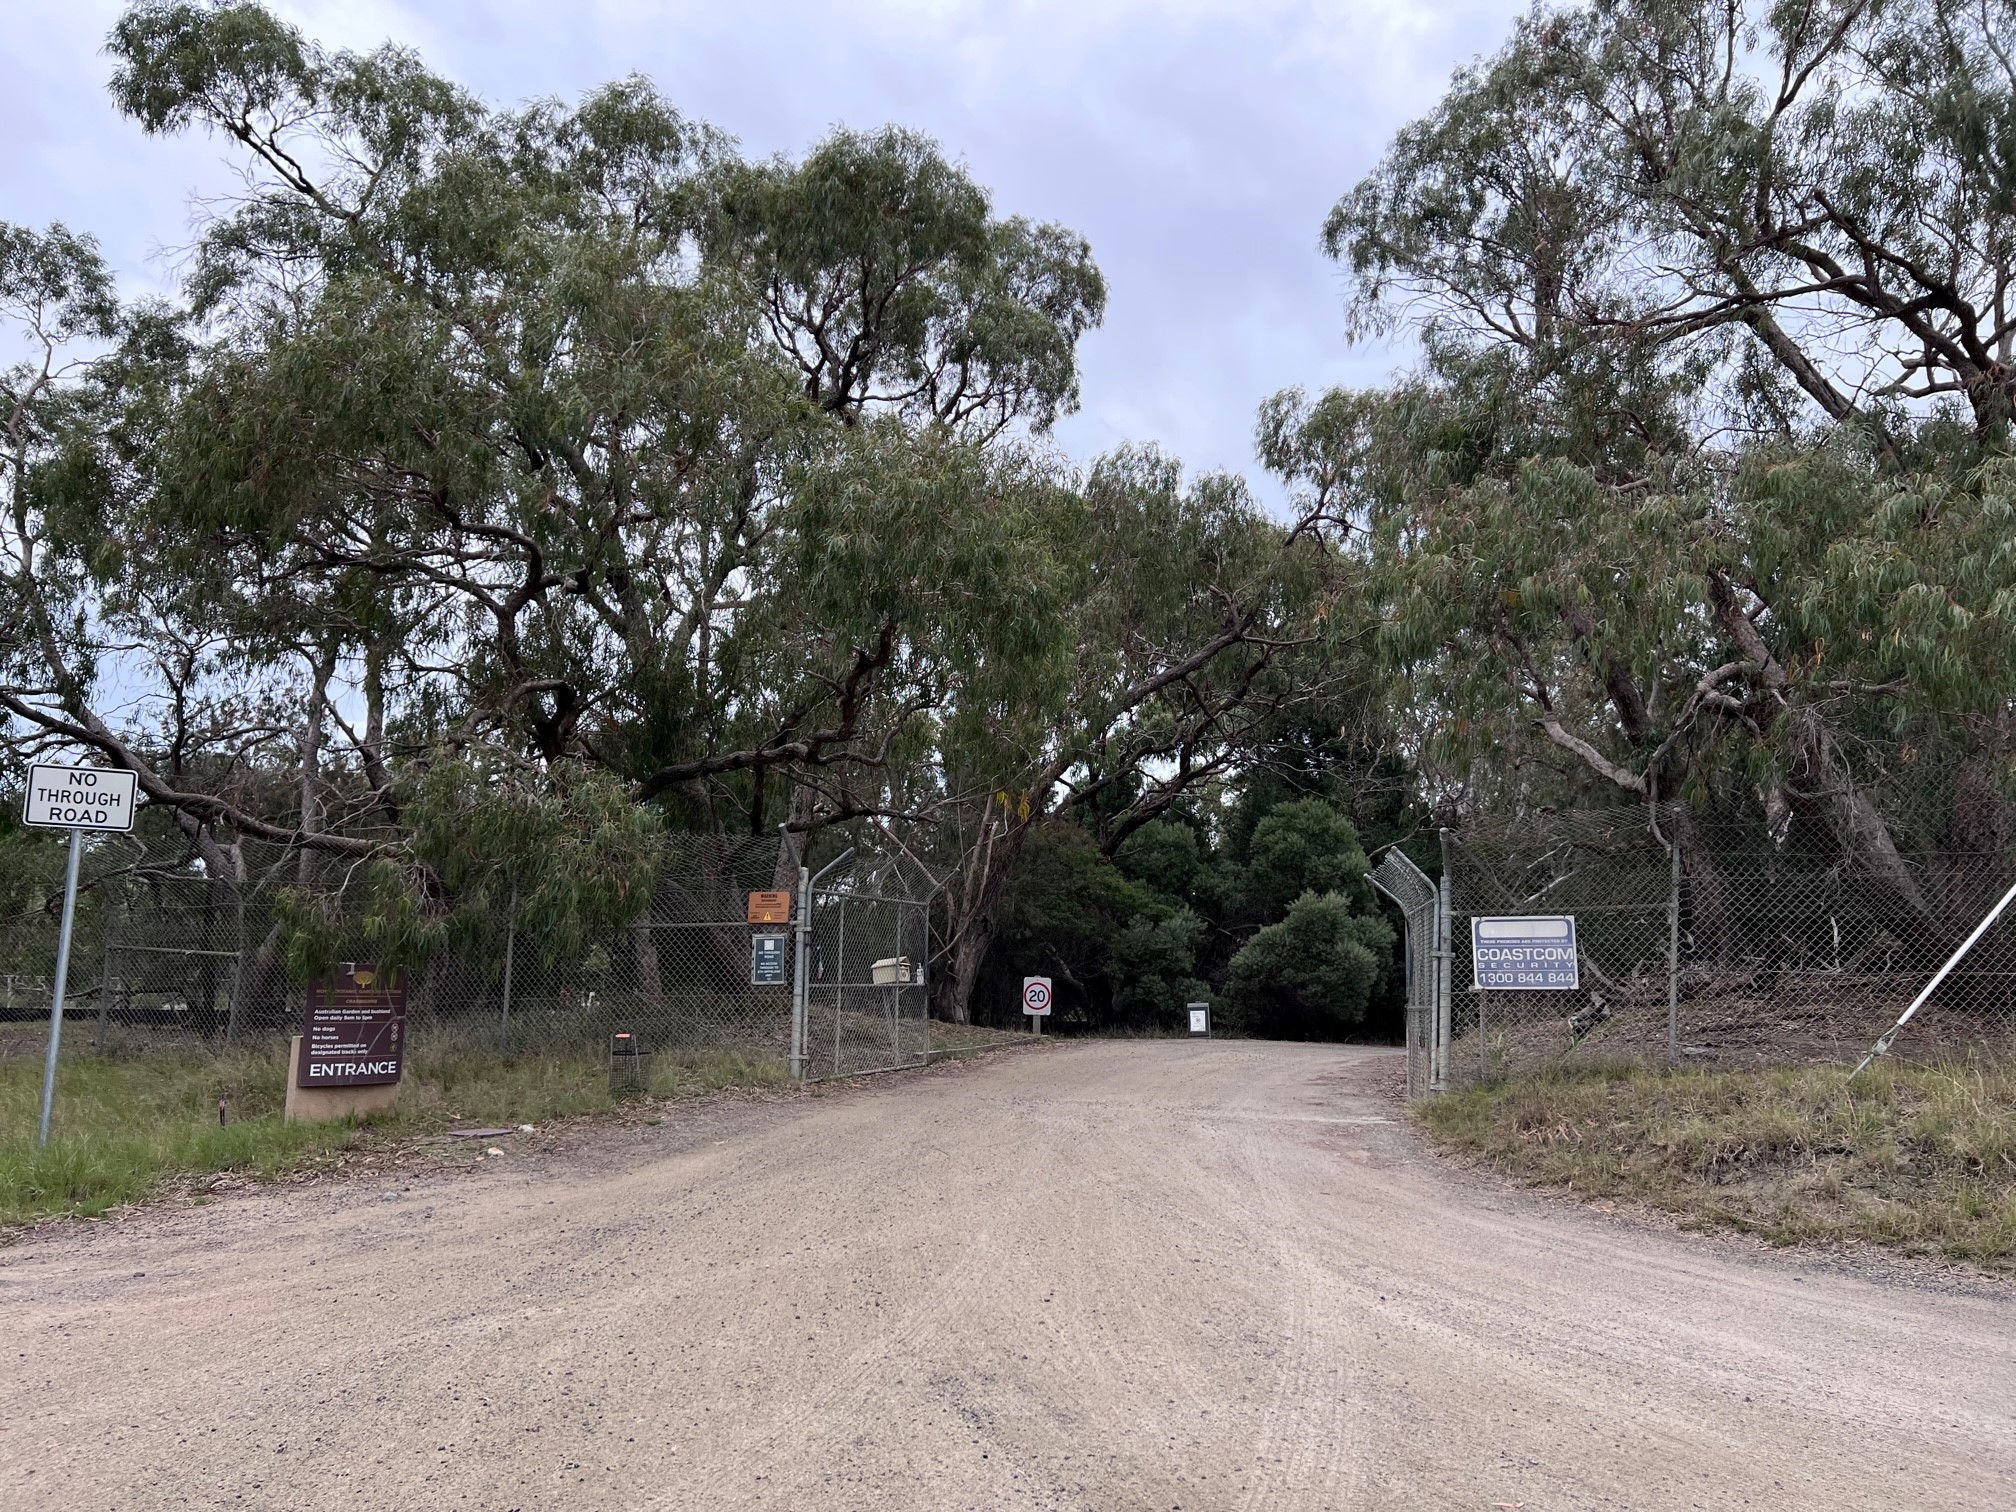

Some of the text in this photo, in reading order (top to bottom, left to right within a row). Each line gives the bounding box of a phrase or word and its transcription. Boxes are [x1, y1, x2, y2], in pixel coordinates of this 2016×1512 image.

[69, 772, 97, 787] NO
[38, 788, 121, 806] THROUGH
[49, 807, 107, 823] ROAD
[1478, 948, 1573, 960] COASTCOM
[1480, 973, 1574, 983] 1300 844 844
[1029, 990, 1045, 1002] 20
[310, 1061, 396, 1076] ENTRANCE
